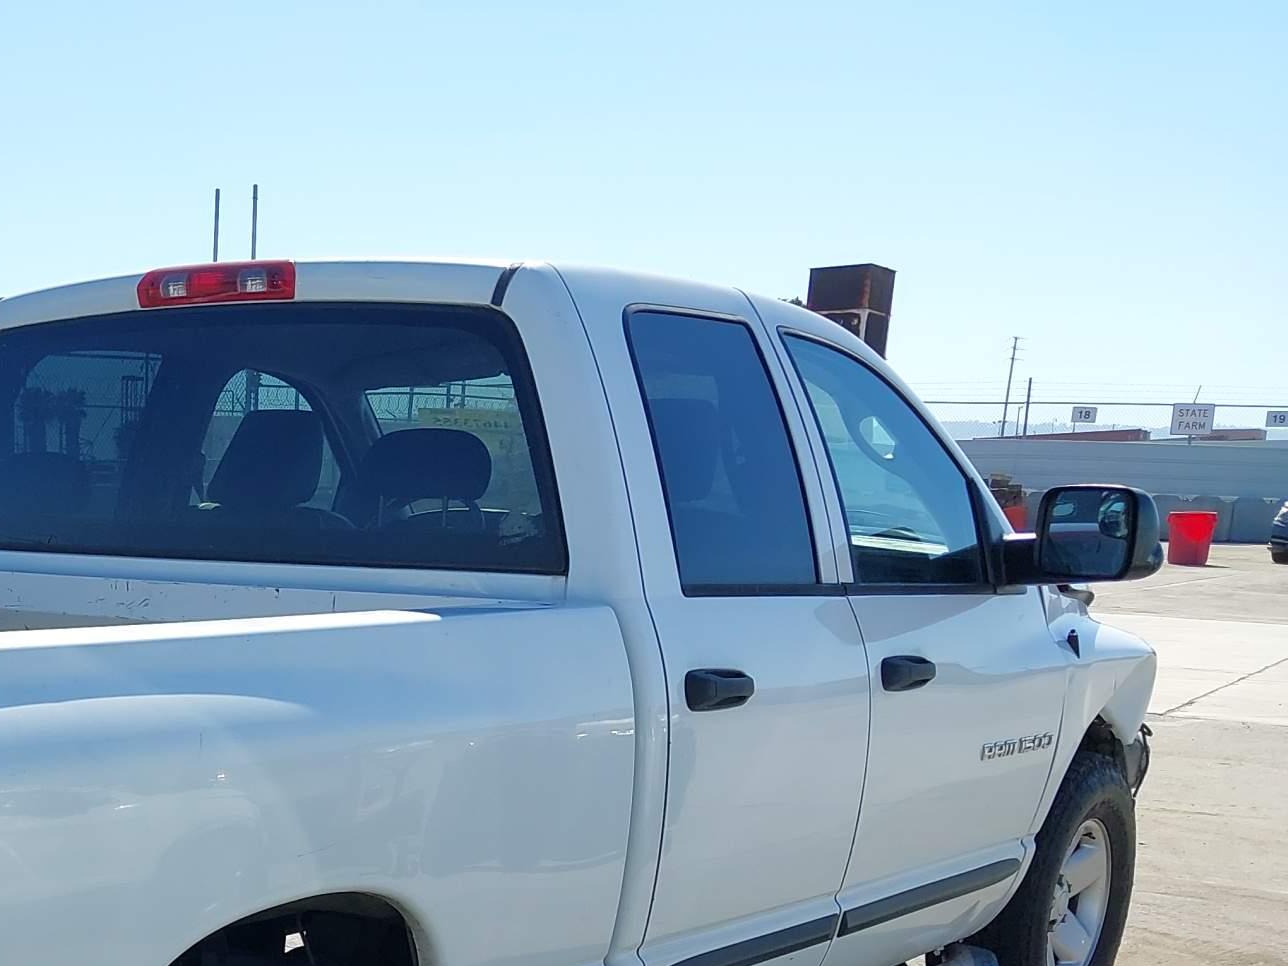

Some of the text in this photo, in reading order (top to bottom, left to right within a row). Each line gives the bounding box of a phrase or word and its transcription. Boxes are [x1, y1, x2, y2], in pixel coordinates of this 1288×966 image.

[1077, 410, 1091, 420] 18
[1178, 408, 1209, 418] STATE
[1272, 414, 1286, 424] 19
[1177, 421, 1206, 431] FARM
[980, 732, 1054, 761] RAM 1500
